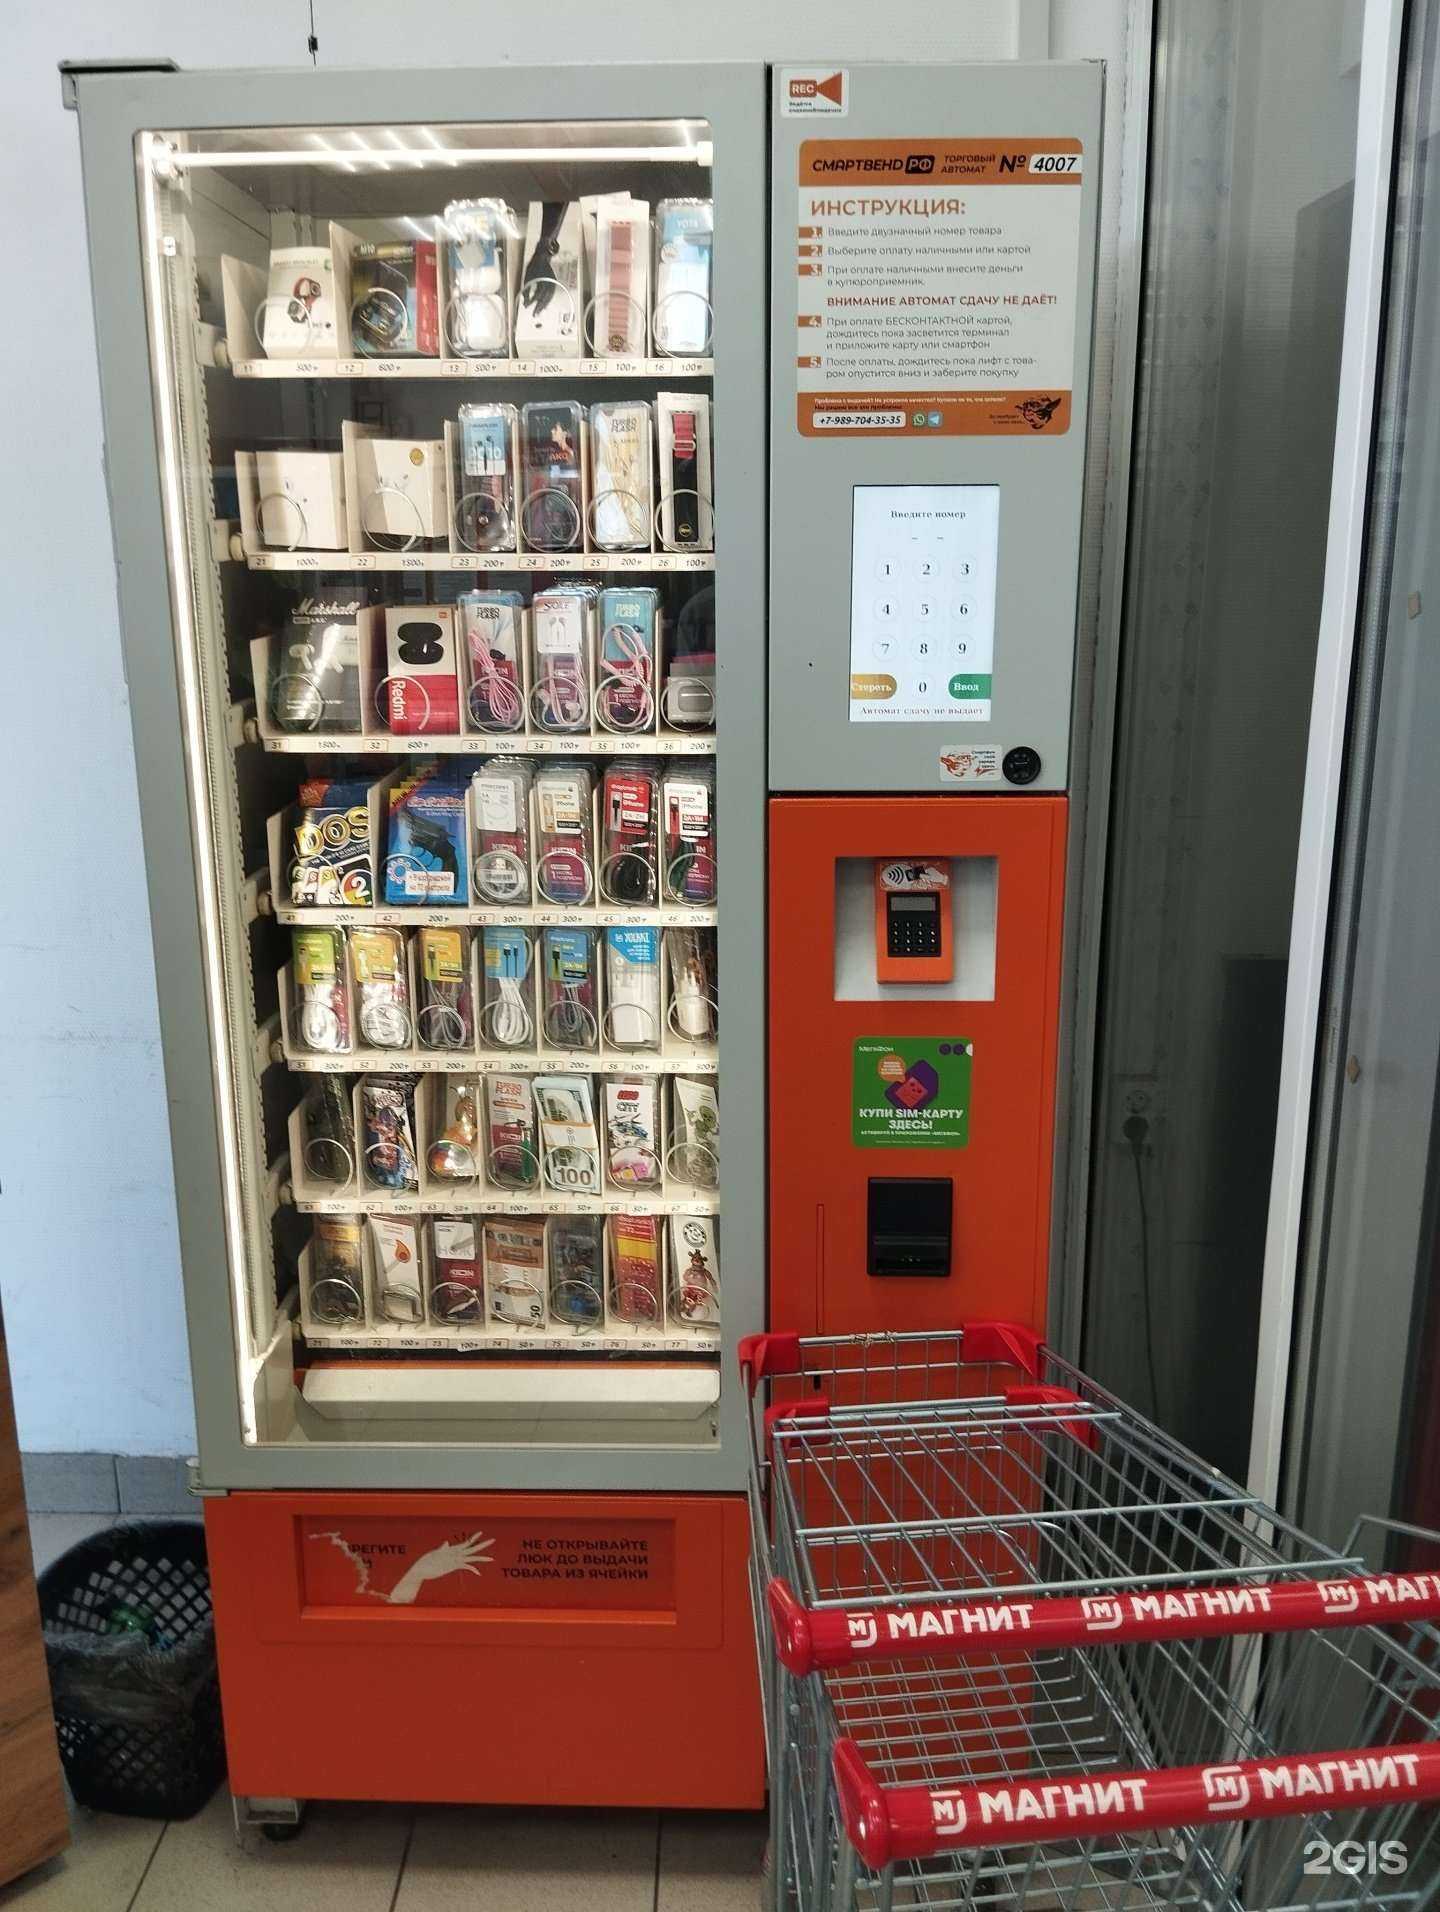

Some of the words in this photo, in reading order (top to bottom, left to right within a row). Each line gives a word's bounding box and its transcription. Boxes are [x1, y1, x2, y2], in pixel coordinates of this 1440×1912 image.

[792, 84, 815, 94] REC
[909, 158, 932, 171] РФ
[945, 154, 996, 163] ТОРГОВЫЙ
[1034, 157, 1077, 172] 4007
[941, 165, 986, 174] АВТОМАТ
[811, 198, 965, 217] ИНСТРУКЦИЯ:
[828, 226, 869, 237] Введите
[871, 226, 931, 238] двузначный
[933, 226, 966, 237] номер
[968, 226, 1002, 236] товара
[827, 246, 877, 256] Выберите
[879, 246, 913, 256] оплату
[915, 245, 973, 255] наличными
[975, 245, 994, 254] или
[997, 243, 1031, 255] картой
[827, 265, 848, 276] При
[850, 264, 884, 275] оплате
[887, 264, 944, 275] наличными
[946, 263, 986, 273] внесите
[988, 263, 1023, 274] деньги
[827, 297, 896, 306] ВНИМАНИЕ
[899, 296, 956, 306] АВТОМАТ
[959, 295, 999, 307] СДАЧУ
[1003, 296, 1019, 305] НЕ
[1022, 294, 1057, 306] ДАЁТ!
[827, 317, 847, 327] При
[850, 317, 882, 326] оплате
[886, 315, 974, 326] БЕСКОНТАКТНОЙ
[827, 330, 879, 339] дождитесь
[881, 329, 904, 338] пока
[906, 328, 959, 338] засветится
[962, 328, 1009, 338] терминал
[835, 341, 889, 352] приложите
[892, 341, 919, 351] карту
[922, 341, 939, 349] или
[942, 339, 990, 350] смартфон
[827, 357, 856, 366] После
[898, 356, 951, 367] дождитесь
[953, 357, 975, 365] пока
[978, 355, 1002, 367] лифт
[827, 370, 846, 379] ром
[848, 369, 896, 379] опустится
[899, 369, 921, 377] вниз
[932, 368, 977, 378] заберите
[979, 368, 1018, 378] покупку
[820, 415, 901, 425] +7-989-704-35-35
[891, 509, 932, 519] Введите
[934, 510, 966, 520] номер
[884, 564, 891, 575] 1
[922, 564, 930, 575] 2
[961, 564, 969, 575] 3
[291, 598, 360, 616] Marshall
[882, 604, 890, 615] 4
[921, 604, 928, 615] 5
[959, 604, 968, 615] 6
[881, 644, 890, 654] 7
[920, 643, 928, 654] 8
[958, 643, 966, 654] 9
[851, 682, 892, 694] Стереть
[918, 682, 927, 694] 0
[953, 682, 979, 693] Ввод
[392, 680, 407, 720] Redmi
[860, 706, 900, 715] Автомат
[859, 1109, 893, 1118] КУПИ
[896, 1108, 963, 1119] SIM-КАРТУ
[889, 1120, 933, 1130] ЗДЕСЬ!
[557, 1167, 591, 1185] 100
[349, 1544, 407, 1554] РЕГИТЕ
[522, 1539, 542, 1550] НЕ
[546, 1538, 648, 1550] ОТКРЫВАЙТЕ
[517, 1553, 552, 1564] ЛЮК
[556, 1554, 578, 1565] ДО
[583, 1553, 648, 1565] ВЫДАЧИ
[502, 1567, 561, 1579] ТОВАРА
[566, 1568, 584, 1579] ИЗ
[589, 1568, 648, 1579] ЯЧЕЙКИ
[887, 1604, 1033, 1639] МАГНИТ
[1130, 1587, 1272, 1621] МАГНИТ
[979, 1778, 1147, 1824] МАГНИТ
[1259, 1754, 1419, 1799] МАГНИТ
